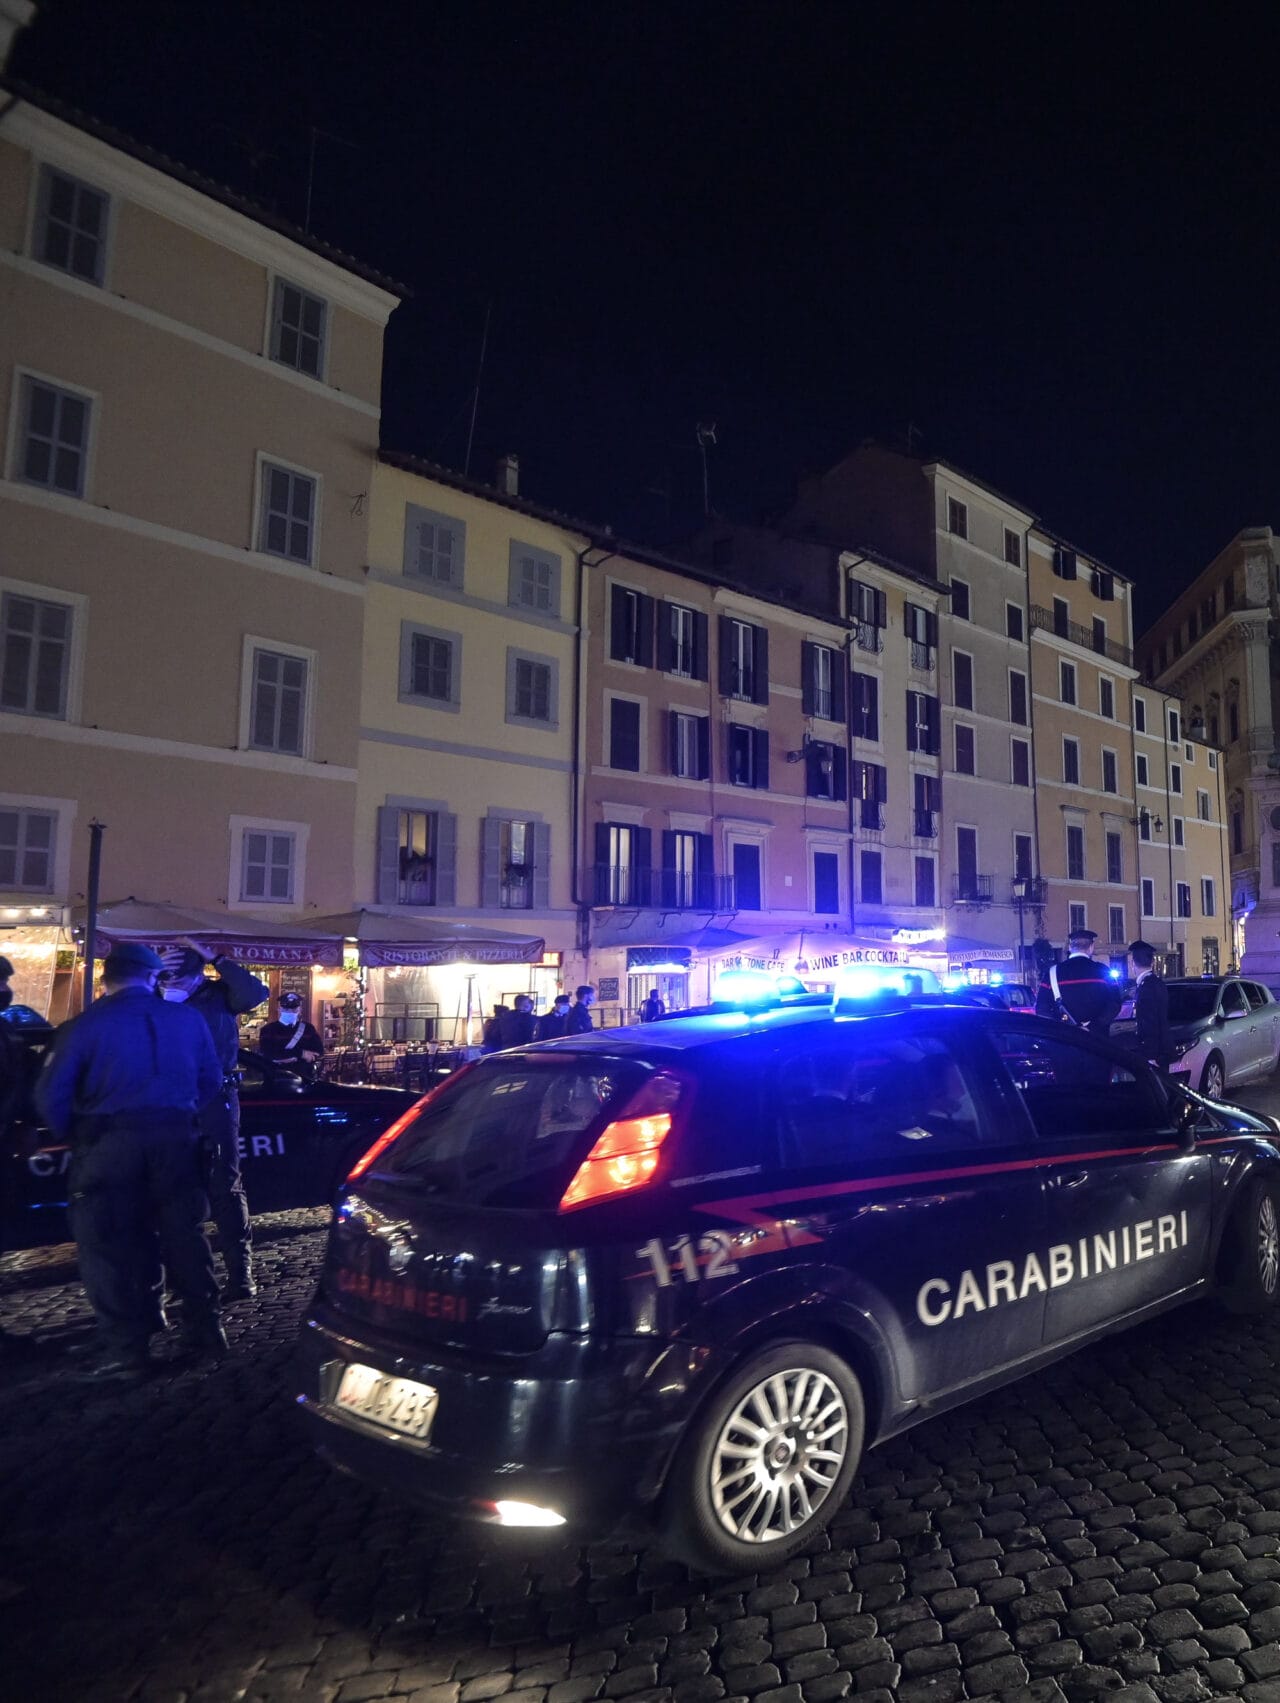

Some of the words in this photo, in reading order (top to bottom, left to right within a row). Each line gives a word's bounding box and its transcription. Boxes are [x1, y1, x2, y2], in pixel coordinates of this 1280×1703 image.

[233, 946, 314, 961] ROMANA
[383, 949, 458, 962] RISTORANTE
[463, 951, 472, 961] &
[476, 949, 524, 961] PIZZERIA
[811, 954, 839, 971] WINE
[842, 952, 863, 964] BAR
[865, 950, 909, 964] COCKTAIL
[634, 1229, 740, 1288] 112
[916, 1210, 1188, 1327] CARABINIERI
